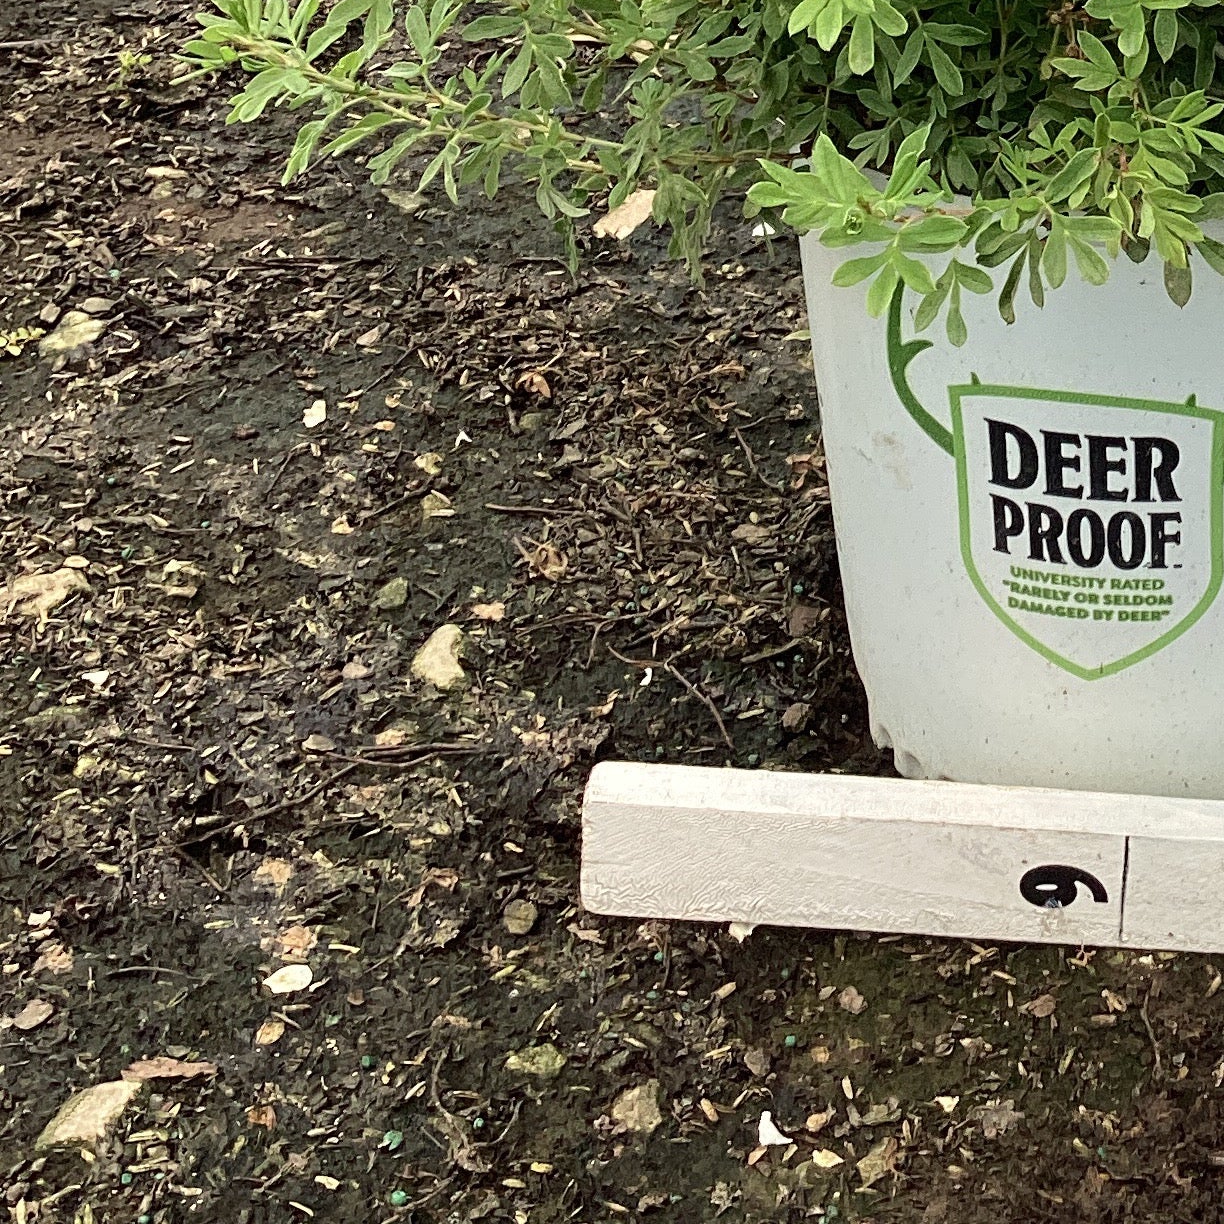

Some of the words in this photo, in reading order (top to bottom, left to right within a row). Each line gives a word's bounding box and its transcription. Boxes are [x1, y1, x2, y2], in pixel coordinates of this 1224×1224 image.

[983, 417, 1182, 503] DEER
[989, 492, 1182, 570] PROOF
[1003, 579, 1071, 602] "RARELY
[1074, 591, 1100, 605] OR
[1103, 593, 1174, 606] SELDOM
[1009, 565, 1106, 590] UNIVERSITY
[1110, 578, 1165, 591] RATED
[1007, 595, 1090, 620] DAMAGED
[1093, 609, 1115, 621] BY
[1118, 610, 1171, 622] DEER"
[1020, 864, 1109, 909] 6
